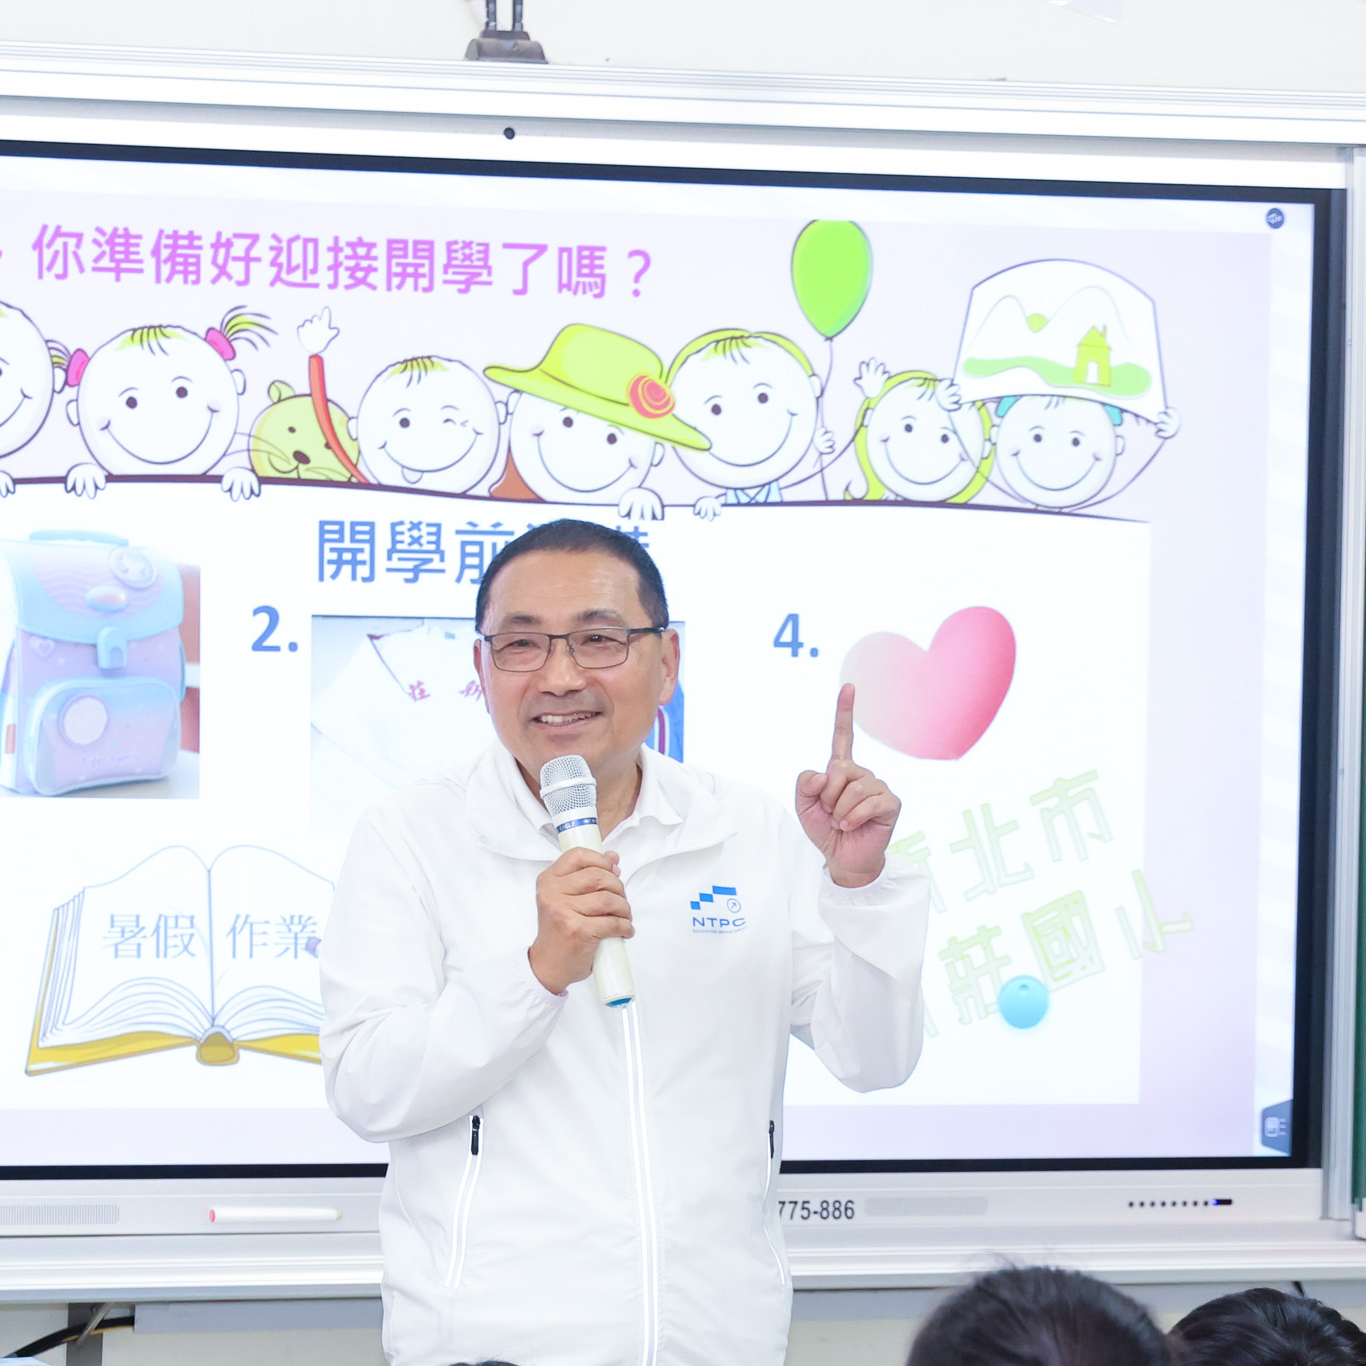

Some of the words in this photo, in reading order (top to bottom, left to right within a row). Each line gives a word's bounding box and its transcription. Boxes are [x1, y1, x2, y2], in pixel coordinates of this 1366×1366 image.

[318, 519, 649, 584] 開學前
[251, 605, 299, 652] 2.
[772, 613, 820, 658] 4.
[102, 913, 197, 960] 暑假
[226, 913, 321, 960] 作業
[692, 917, 747, 928] NTPC
[778, 1199, 855, 1220] 775-886
